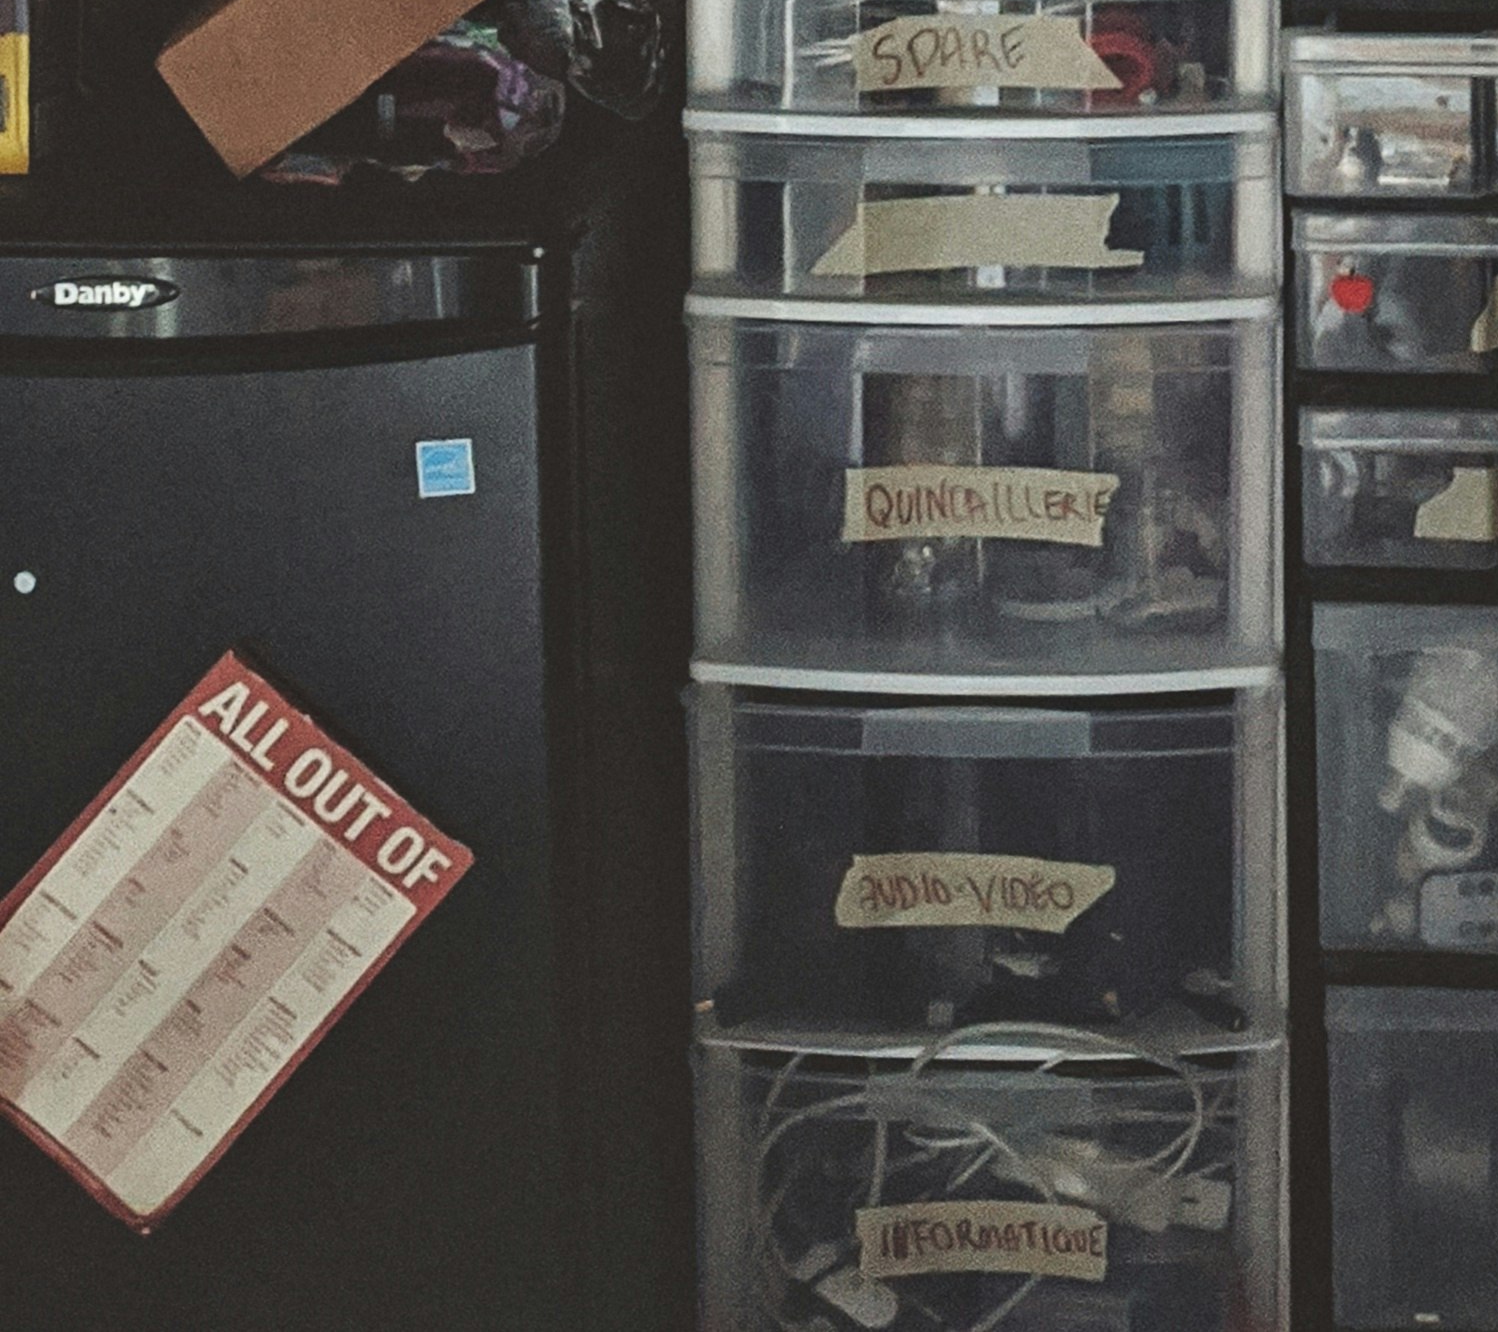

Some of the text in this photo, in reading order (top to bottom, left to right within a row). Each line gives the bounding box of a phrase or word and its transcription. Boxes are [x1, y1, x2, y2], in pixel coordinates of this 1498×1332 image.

[871, 24, 1025, 86] SPARE
[53, 281, 147, 308] Danby
[198, 681, 454, 891] ALL OUT OF
[880, 1218, 1105, 1261] INFORMATIQUE
